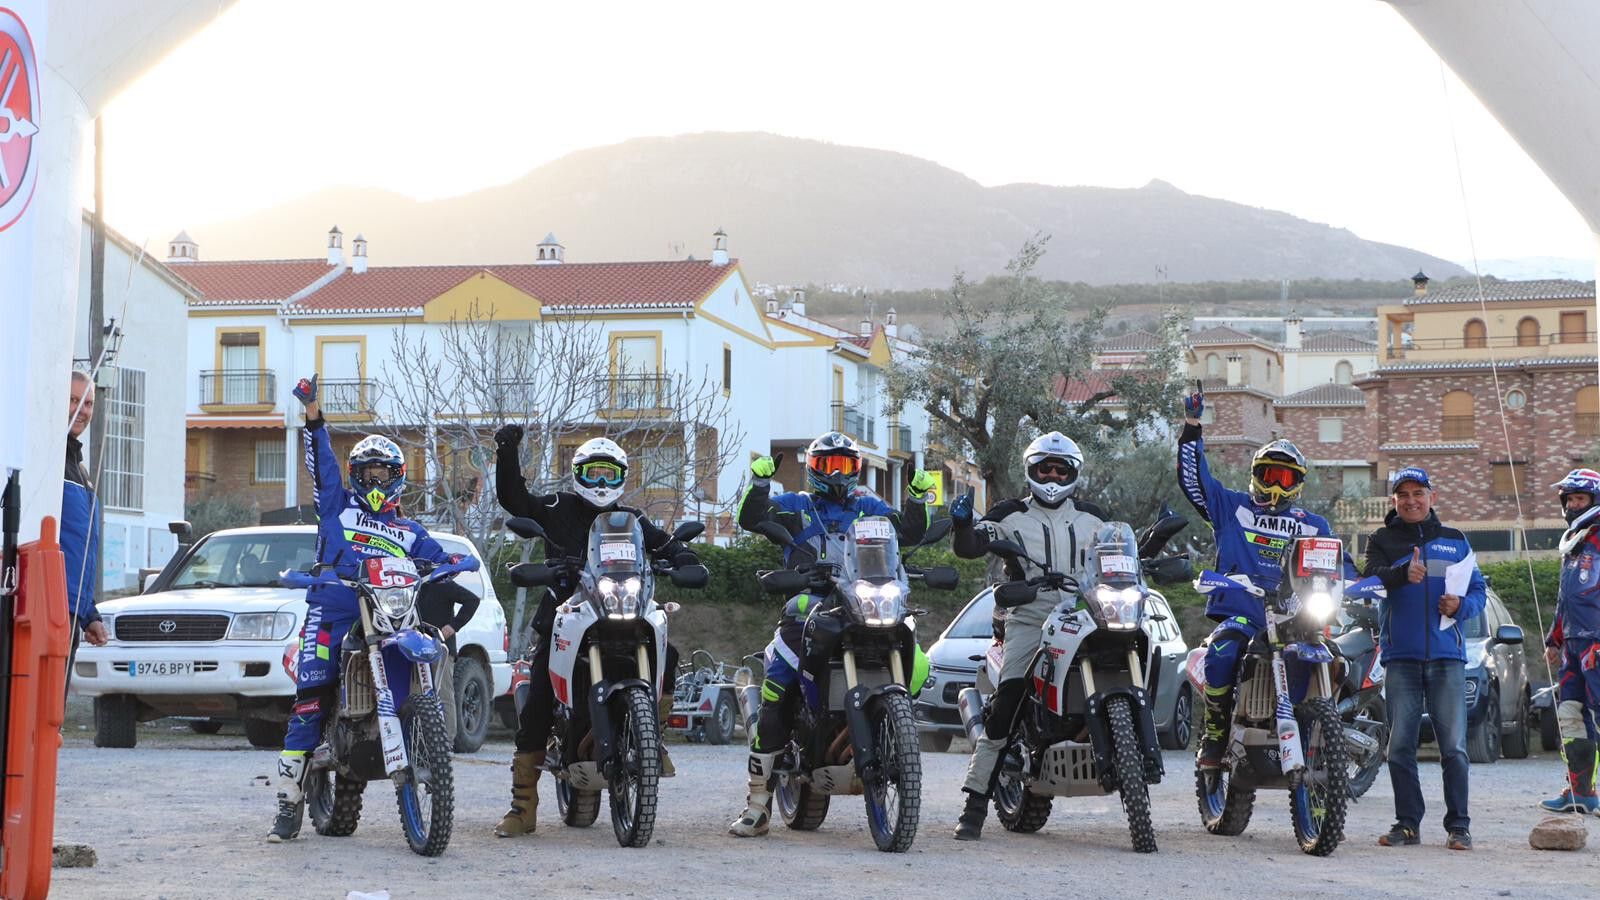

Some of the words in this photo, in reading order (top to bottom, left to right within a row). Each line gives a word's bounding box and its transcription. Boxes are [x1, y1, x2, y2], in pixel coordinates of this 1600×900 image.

[356, 511, 405, 542] YAMAHA
[1253, 513, 1303, 537] YAMAHA
[874, 528, 890, 537] 115
[1315, 541, 1338, 549] MOTUL
[619, 549, 636, 559] 116
[303, 606, 322, 663] YAMAHA
[138, 663, 165, 674] 9746
[170, 663, 191, 674] BPY
